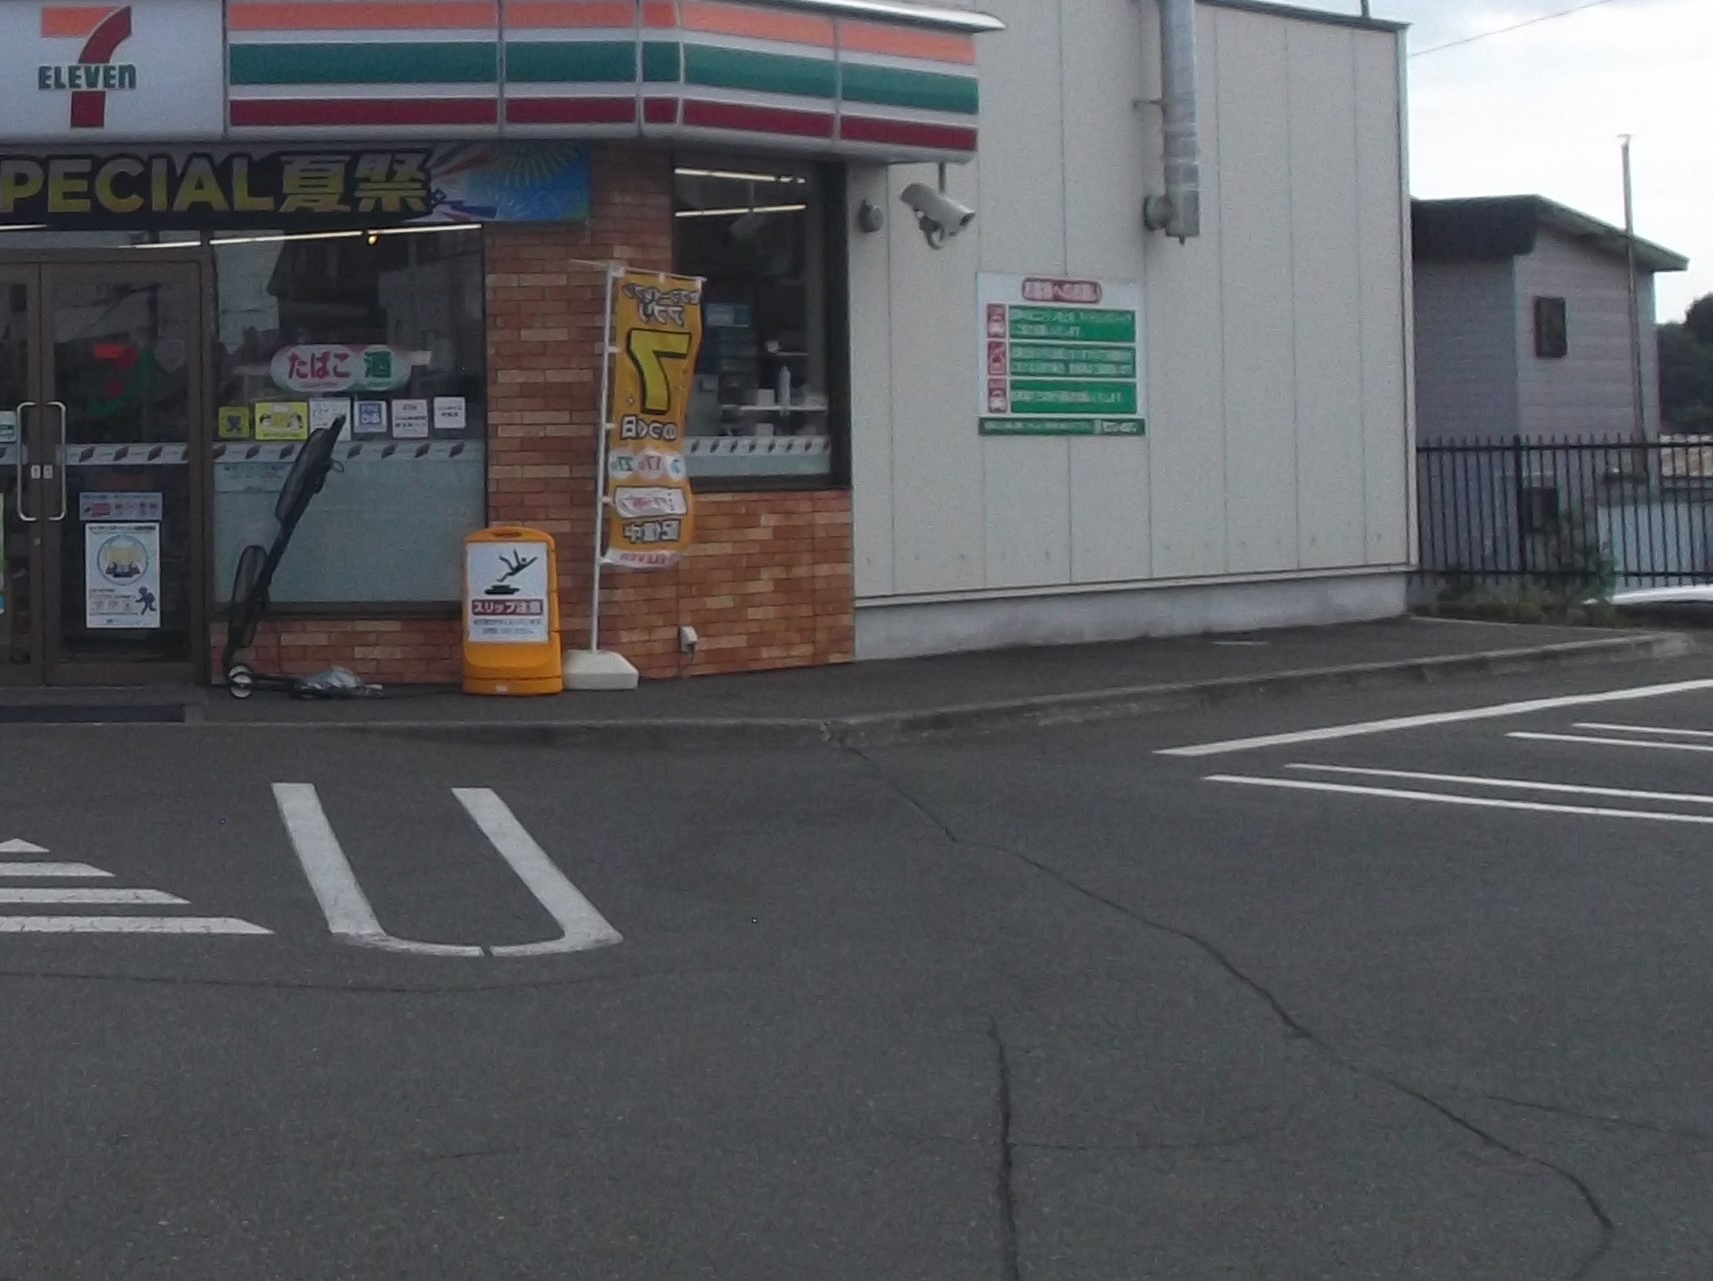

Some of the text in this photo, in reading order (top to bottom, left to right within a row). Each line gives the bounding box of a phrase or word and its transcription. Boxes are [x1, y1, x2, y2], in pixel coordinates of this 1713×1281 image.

[41, 6, 132, 128] 7
[278, 150, 433, 213] 夏祭
[287, 351, 352, 381] たばこ
[363, 350, 393, 380] 酒
